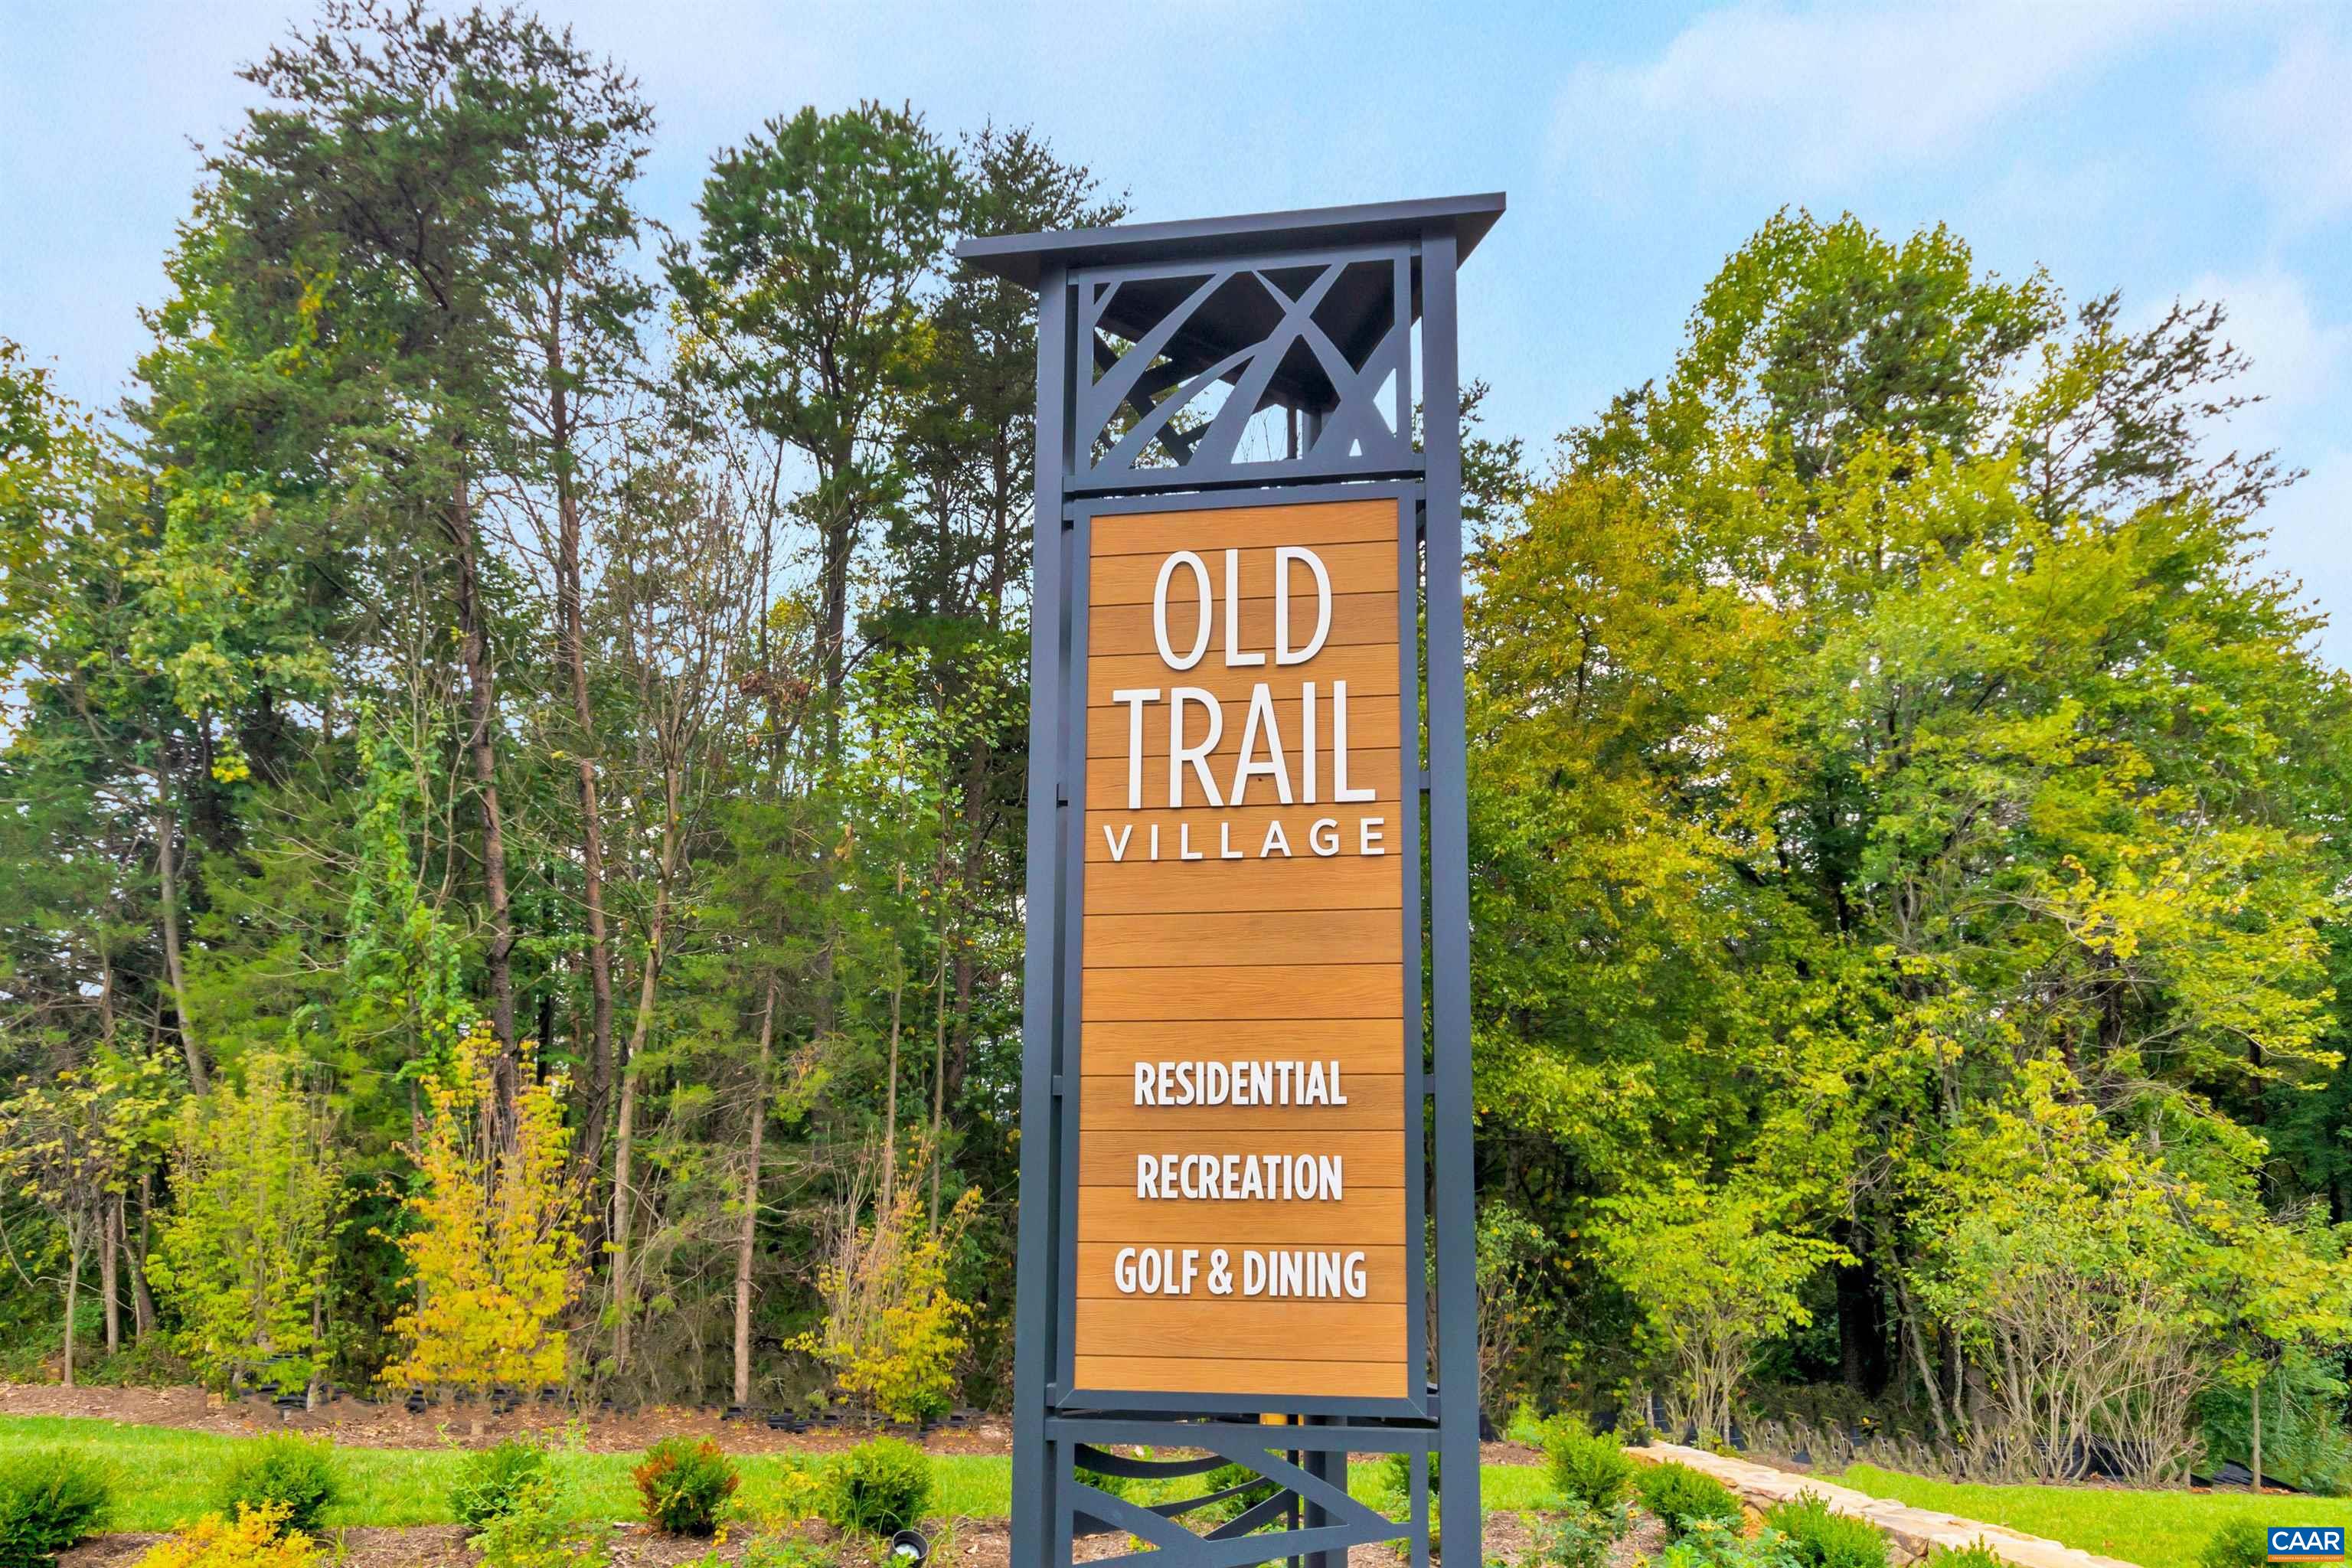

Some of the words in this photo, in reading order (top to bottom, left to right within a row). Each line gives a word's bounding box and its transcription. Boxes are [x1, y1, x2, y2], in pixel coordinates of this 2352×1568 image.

[1153, 546, 1332, 671] OLD
[1112, 680, 1376, 809] TRAIL
[1103, 817, 1386, 862] VILLAGE
[1134, 1060, 1348, 1106] RESIDENTIAL
[1137, 1154, 1343, 1200] RECREATION
[1114, 1248, 1199, 1294] GOLF
[1207, 1249, 1233, 1295] &
[1243, 1250, 1367, 1298] DINING
